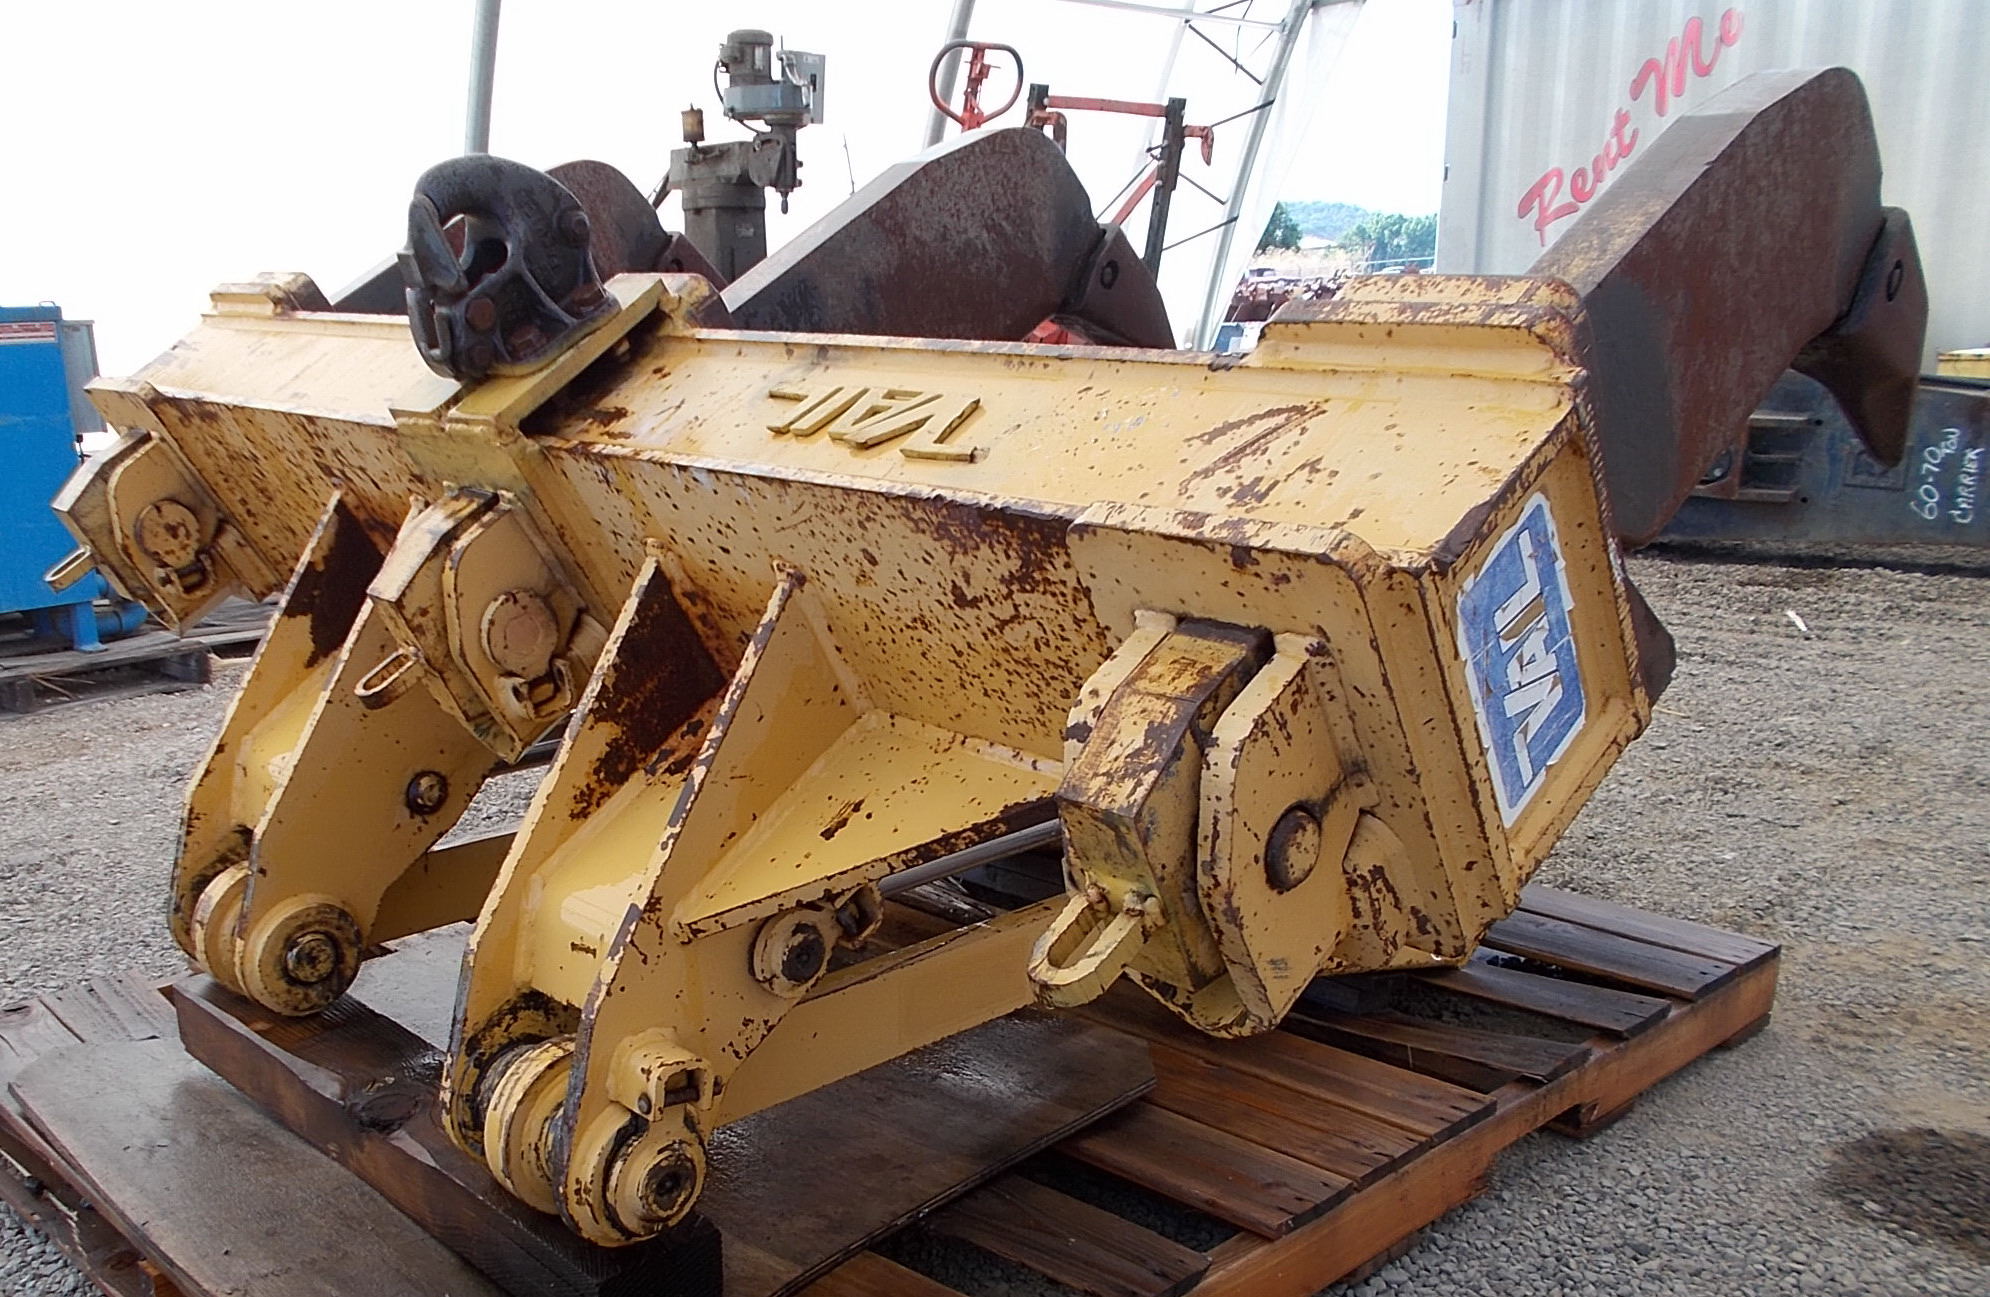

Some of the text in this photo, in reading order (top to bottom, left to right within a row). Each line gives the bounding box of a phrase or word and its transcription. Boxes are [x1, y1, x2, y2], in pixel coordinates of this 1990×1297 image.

[1518, 8, 1743, 247] Rent Me
[766, 386, 981, 463] VAIL
[1910, 447, 1942, 520] 60-70
[1493, 528, 1563, 789] VAIL
